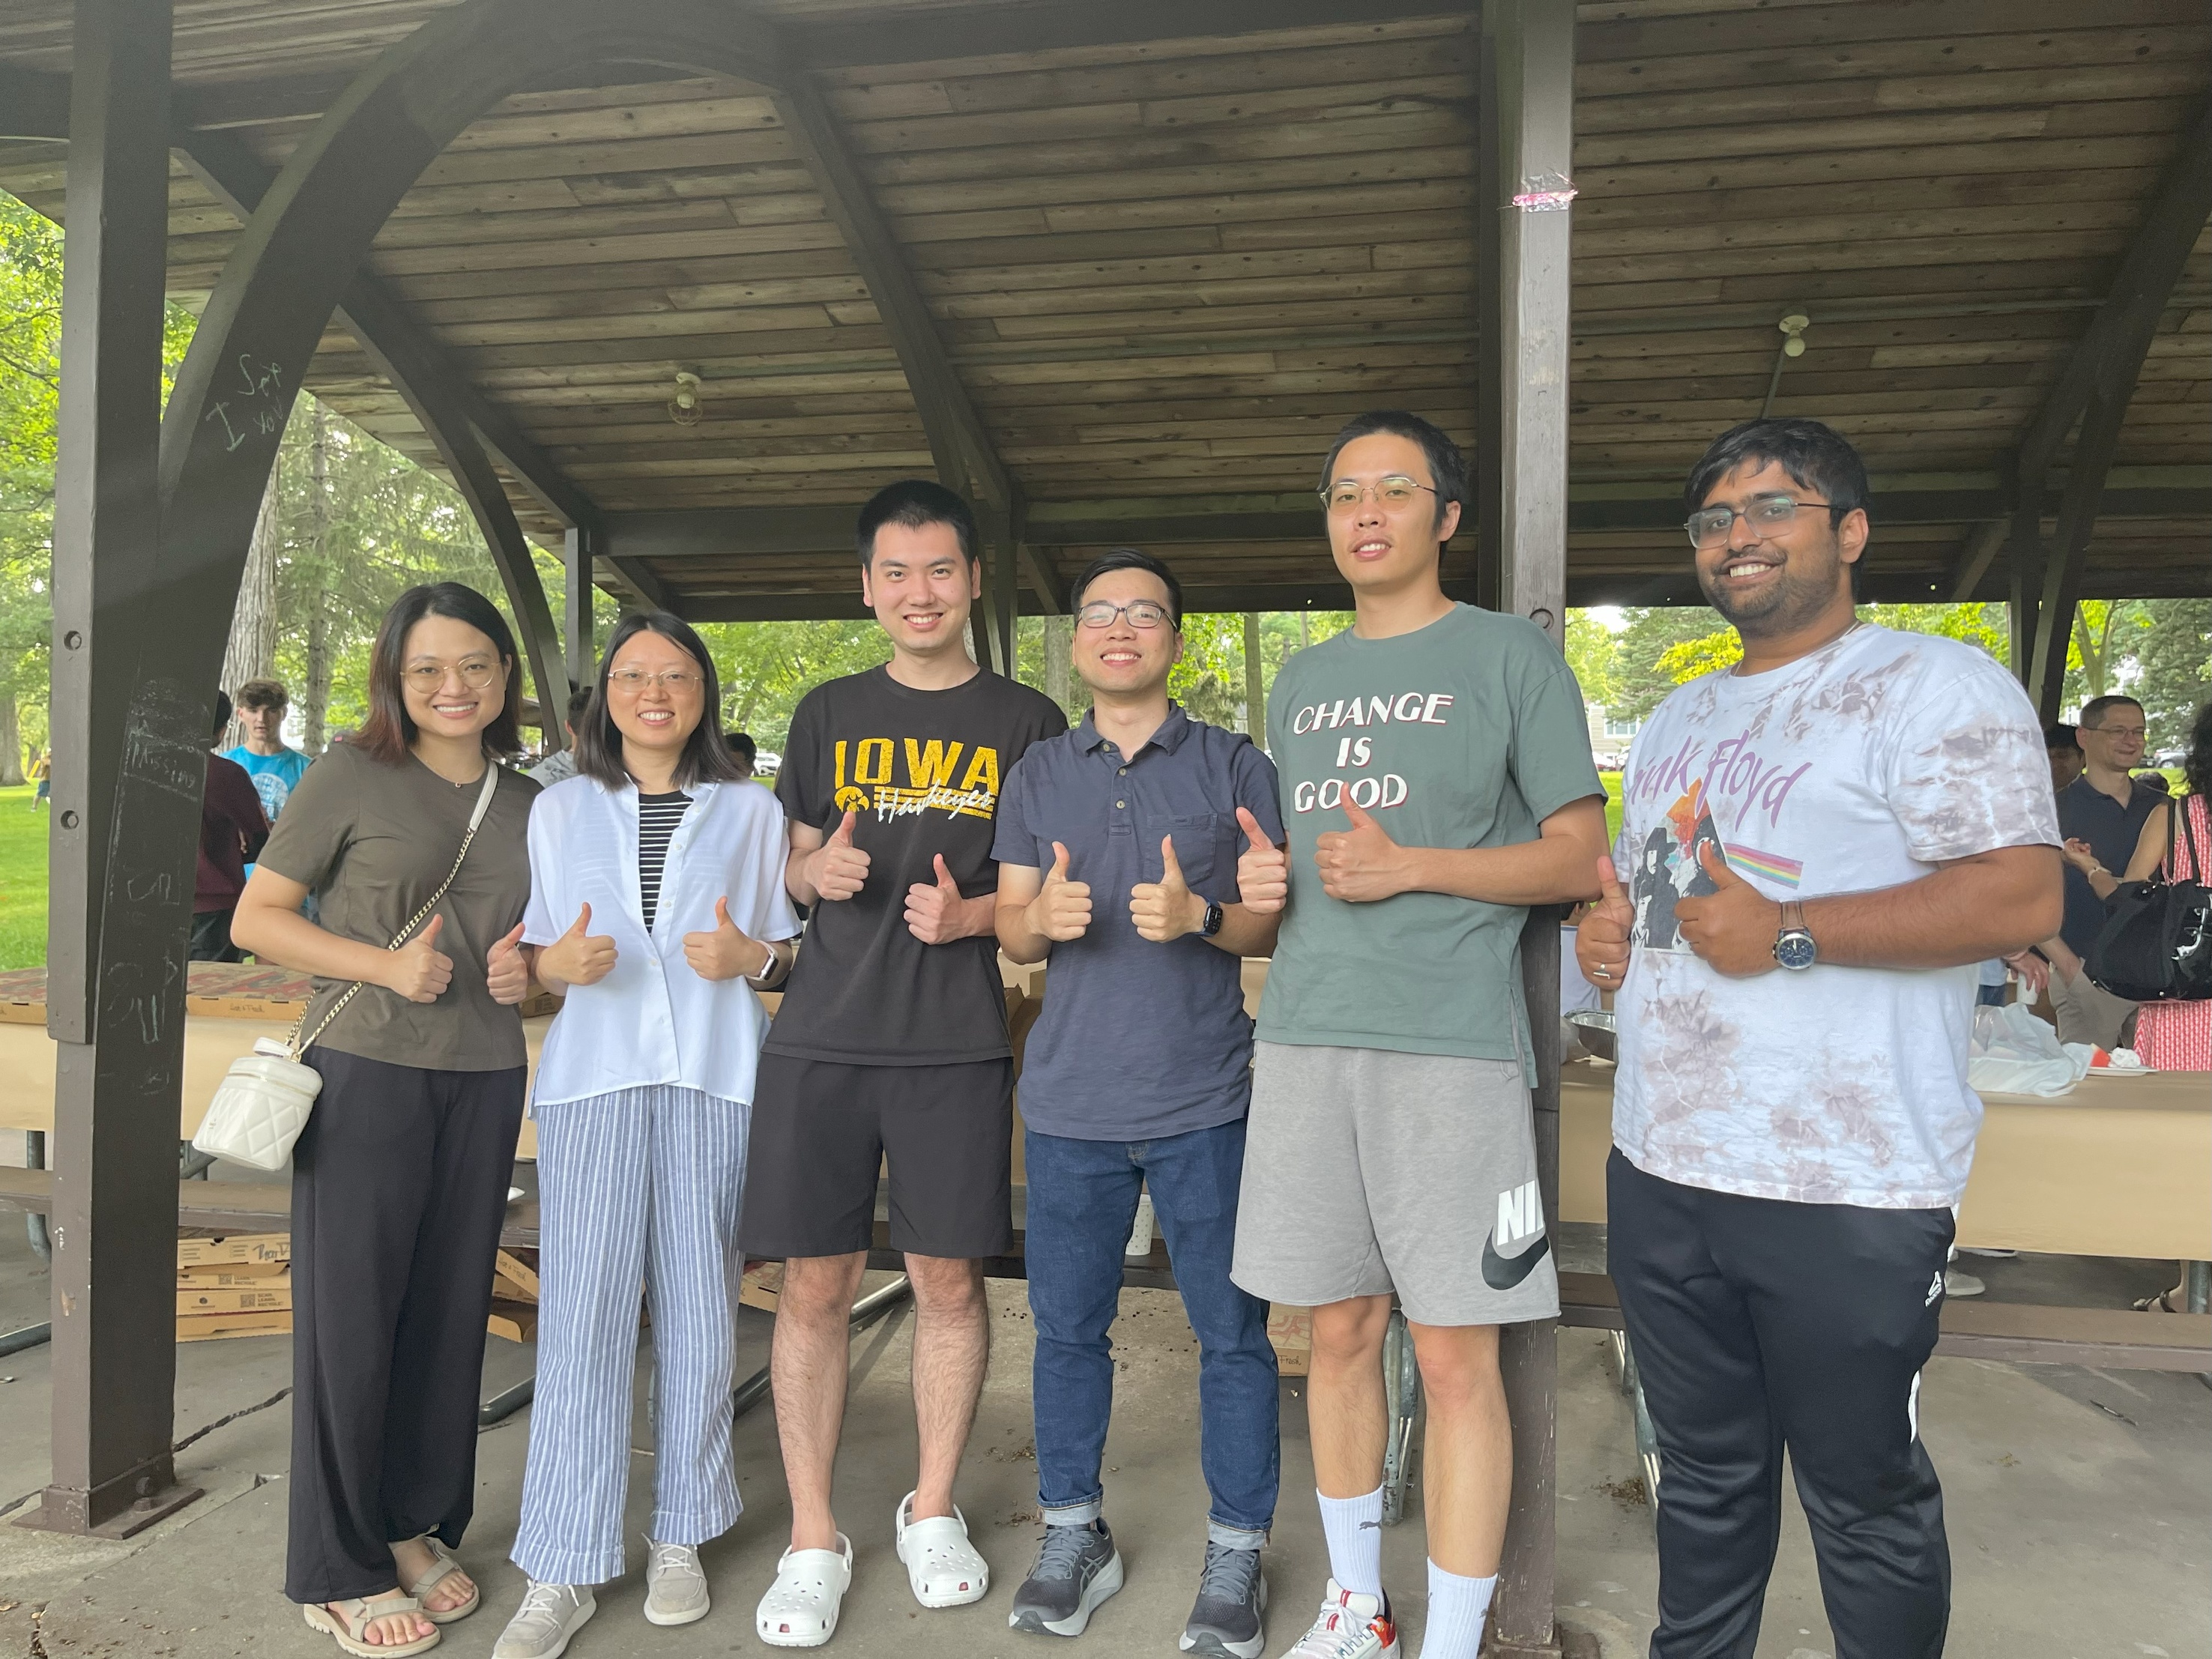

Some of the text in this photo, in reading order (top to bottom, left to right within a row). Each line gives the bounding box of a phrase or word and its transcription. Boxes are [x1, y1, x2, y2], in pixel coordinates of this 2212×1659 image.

[1293, 692, 1454, 735] CHANGE
[835, 737, 999, 797] IOWA
[1336, 737, 1373, 768] IS
[877, 778, 994, 825] Hawkeyes
[1294, 773, 1409, 814] GOOD
[1631, 728, 1813, 833] ink Floyd
[1496, 1179, 1544, 1246] NI
[1278, 1354, 1302, 1365] Fresh
